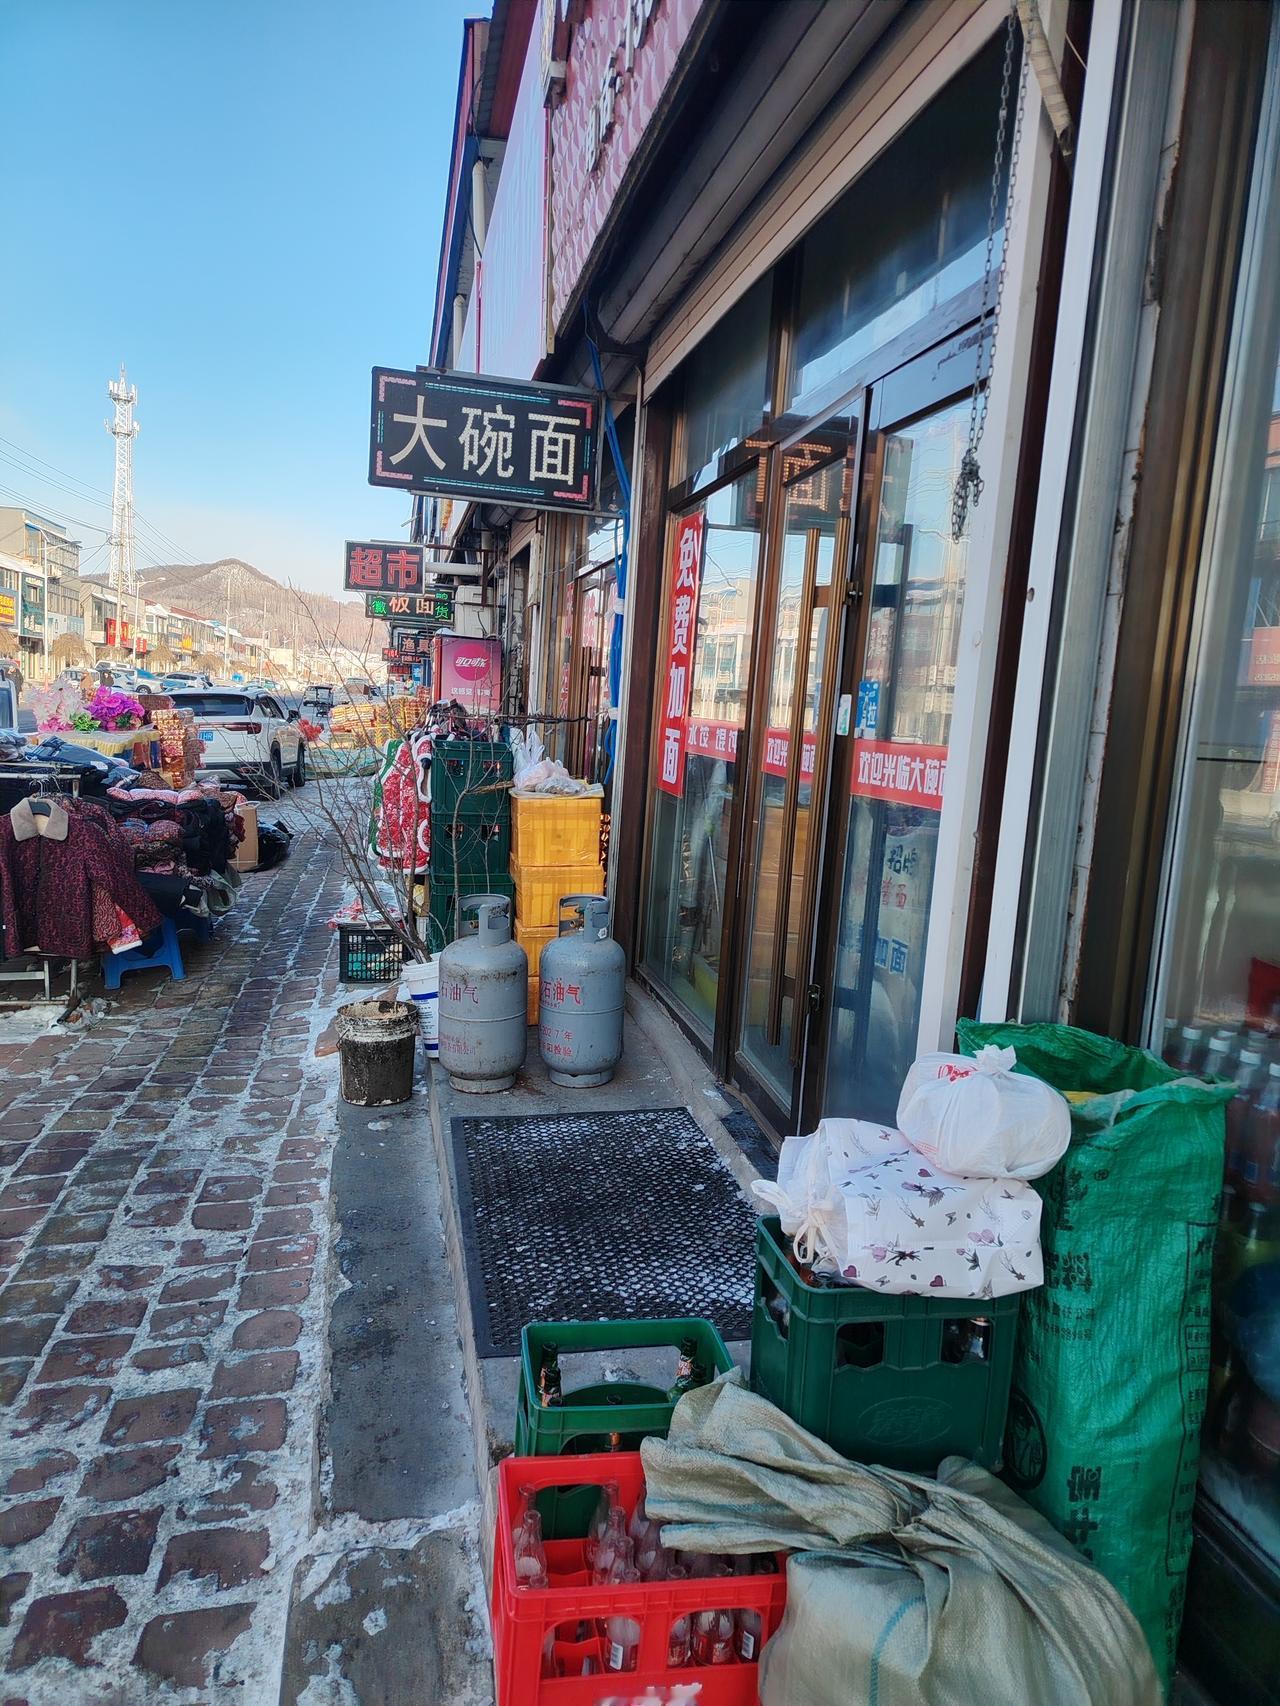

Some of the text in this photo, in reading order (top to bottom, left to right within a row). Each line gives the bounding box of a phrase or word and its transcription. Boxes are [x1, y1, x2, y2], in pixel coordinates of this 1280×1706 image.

[389, 395, 581, 486] 大碗面
[349, 547, 420, 589] 超市
[662, 527, 694, 784] 免费加面
[688, 724, 710, 748] 水饺
